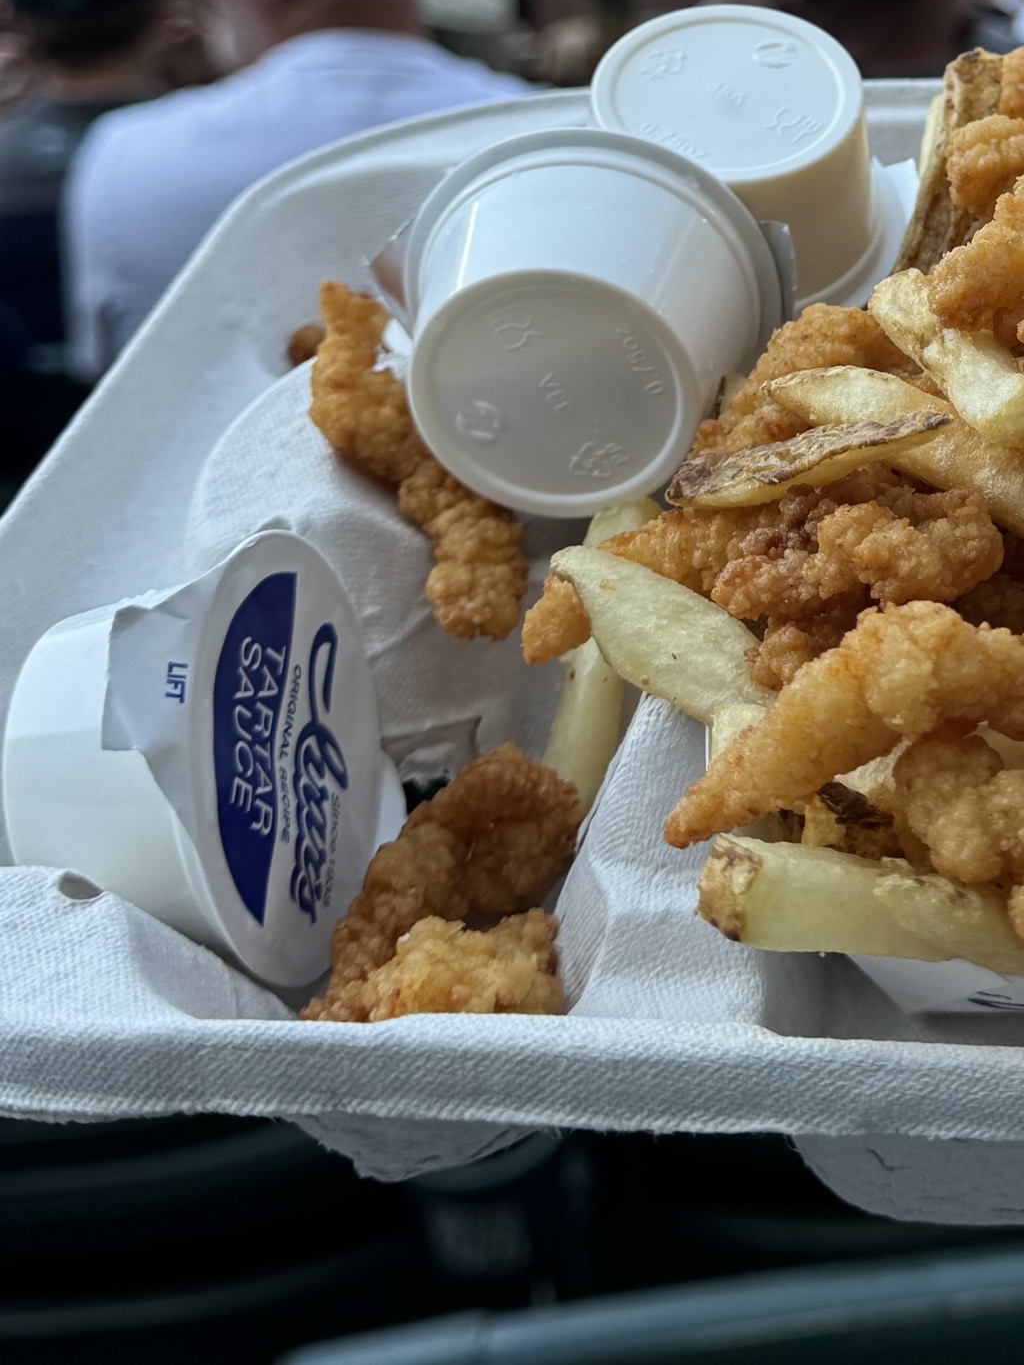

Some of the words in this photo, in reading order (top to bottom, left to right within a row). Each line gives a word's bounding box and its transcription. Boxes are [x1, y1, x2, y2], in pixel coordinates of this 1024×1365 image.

[165, 661, 188, 704] LIFT
[230, 636, 262, 813] SAUCE
[279, 663, 302, 760] ORIGINAL
[250, 645, 287, 836] TARTAR
[279, 767, 293, 843] RECIPE
[329, 792, 341, 854] Since
